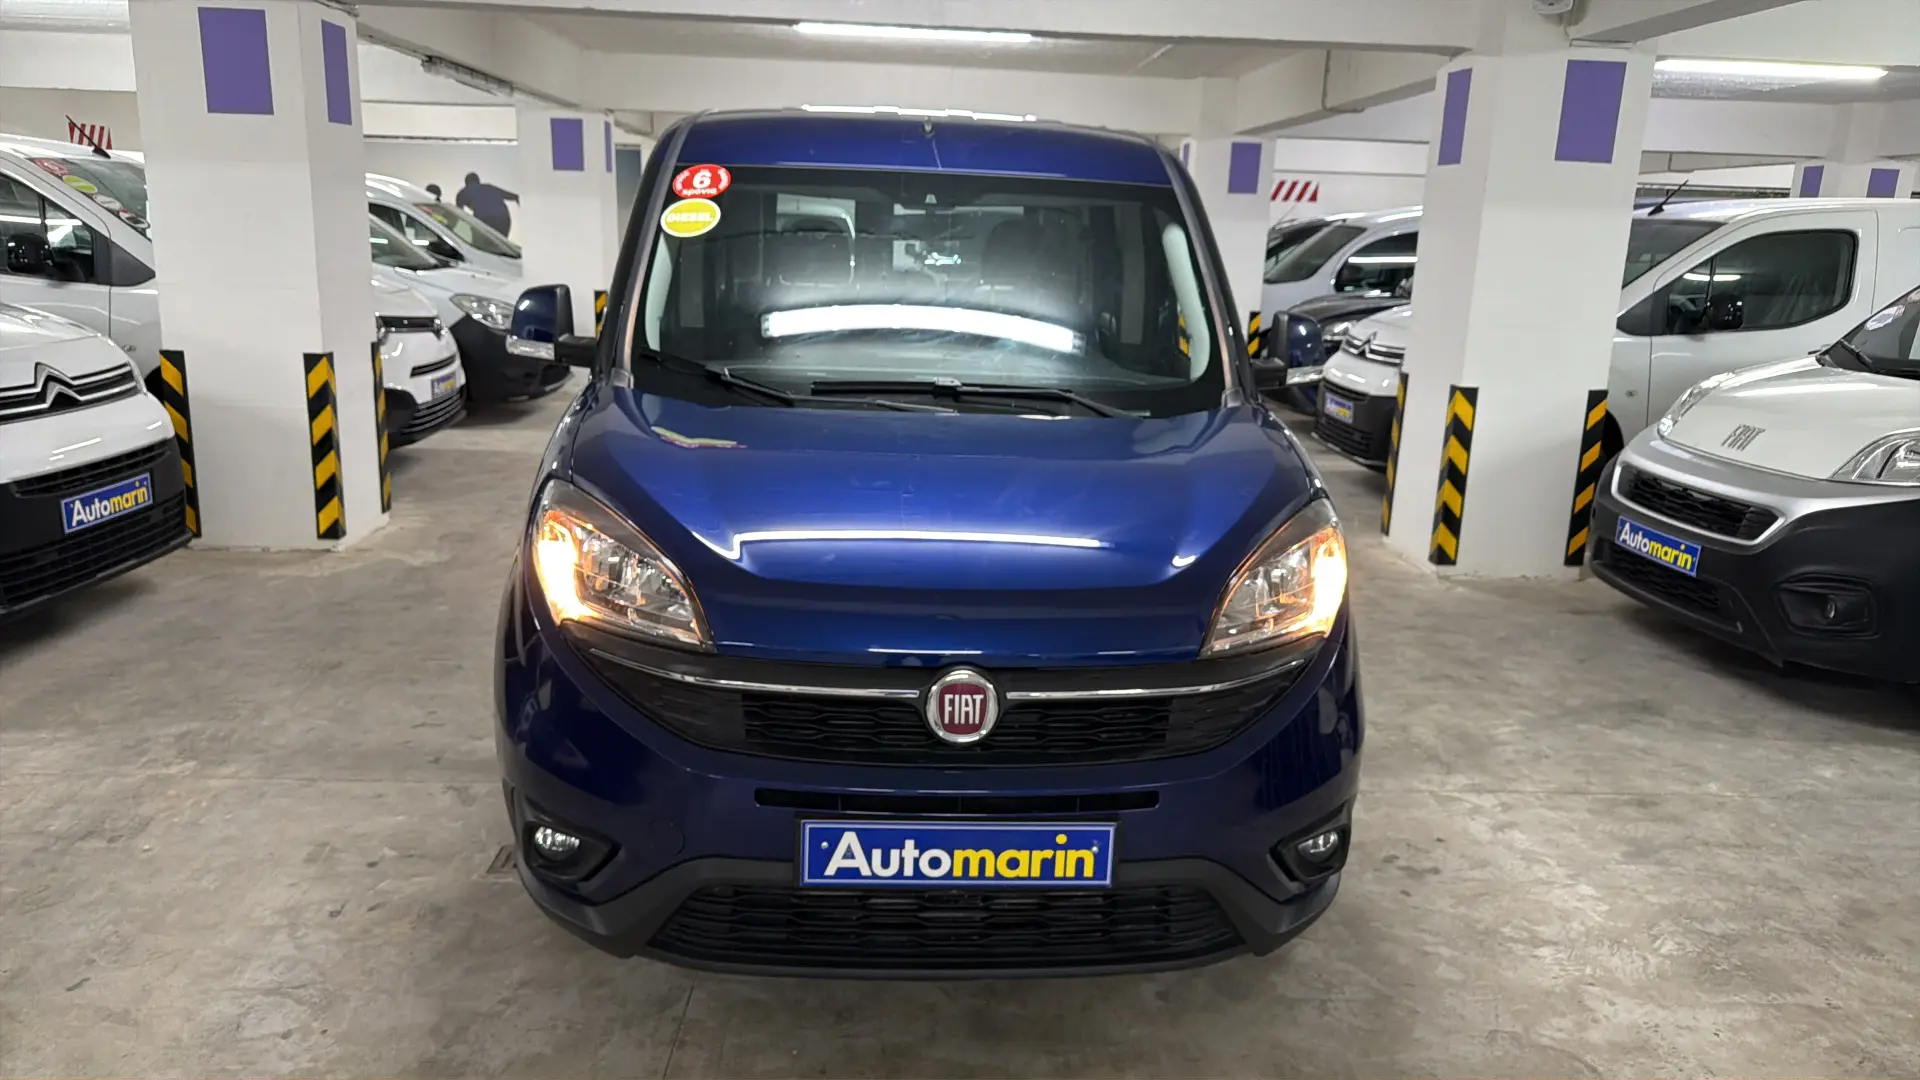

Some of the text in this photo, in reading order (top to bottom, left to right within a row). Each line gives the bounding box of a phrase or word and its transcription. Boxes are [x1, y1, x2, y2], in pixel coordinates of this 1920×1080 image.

[692, 170, 712, 189] 6
[72, 481, 149, 527] Automarin
[1620, 522, 1693, 570] Automarin
[943, 693, 985, 725] FIAT
[823, 831, 1095, 878] Automarin
